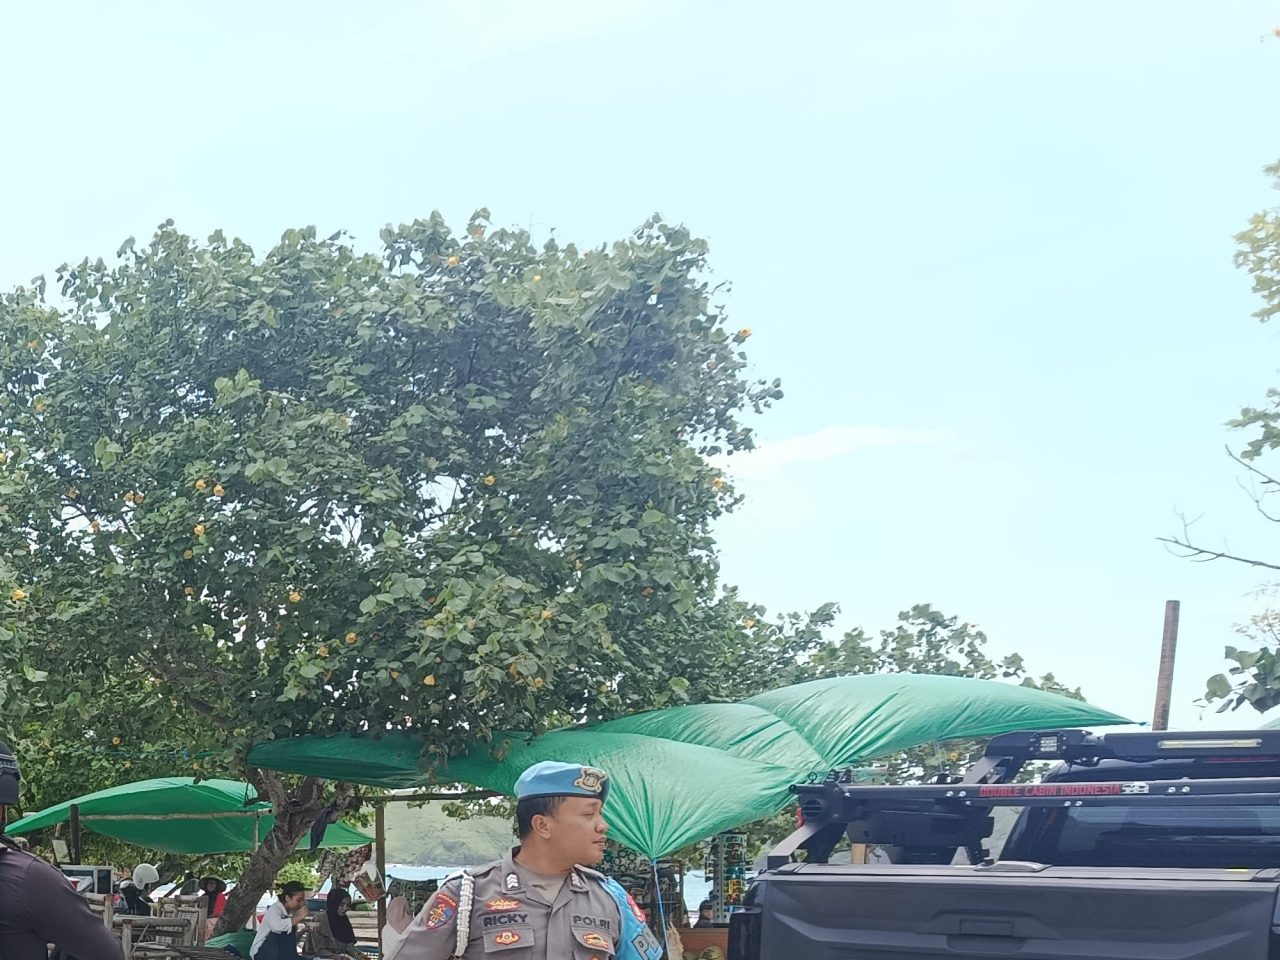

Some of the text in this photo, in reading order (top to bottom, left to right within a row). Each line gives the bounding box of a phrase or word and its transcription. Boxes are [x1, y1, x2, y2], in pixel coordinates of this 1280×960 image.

[979, 784, 1121, 797] DOUBLE CABIN INDONESIA
[483, 913, 528, 928] RICKY
[572, 914, 610, 930] POLRI
